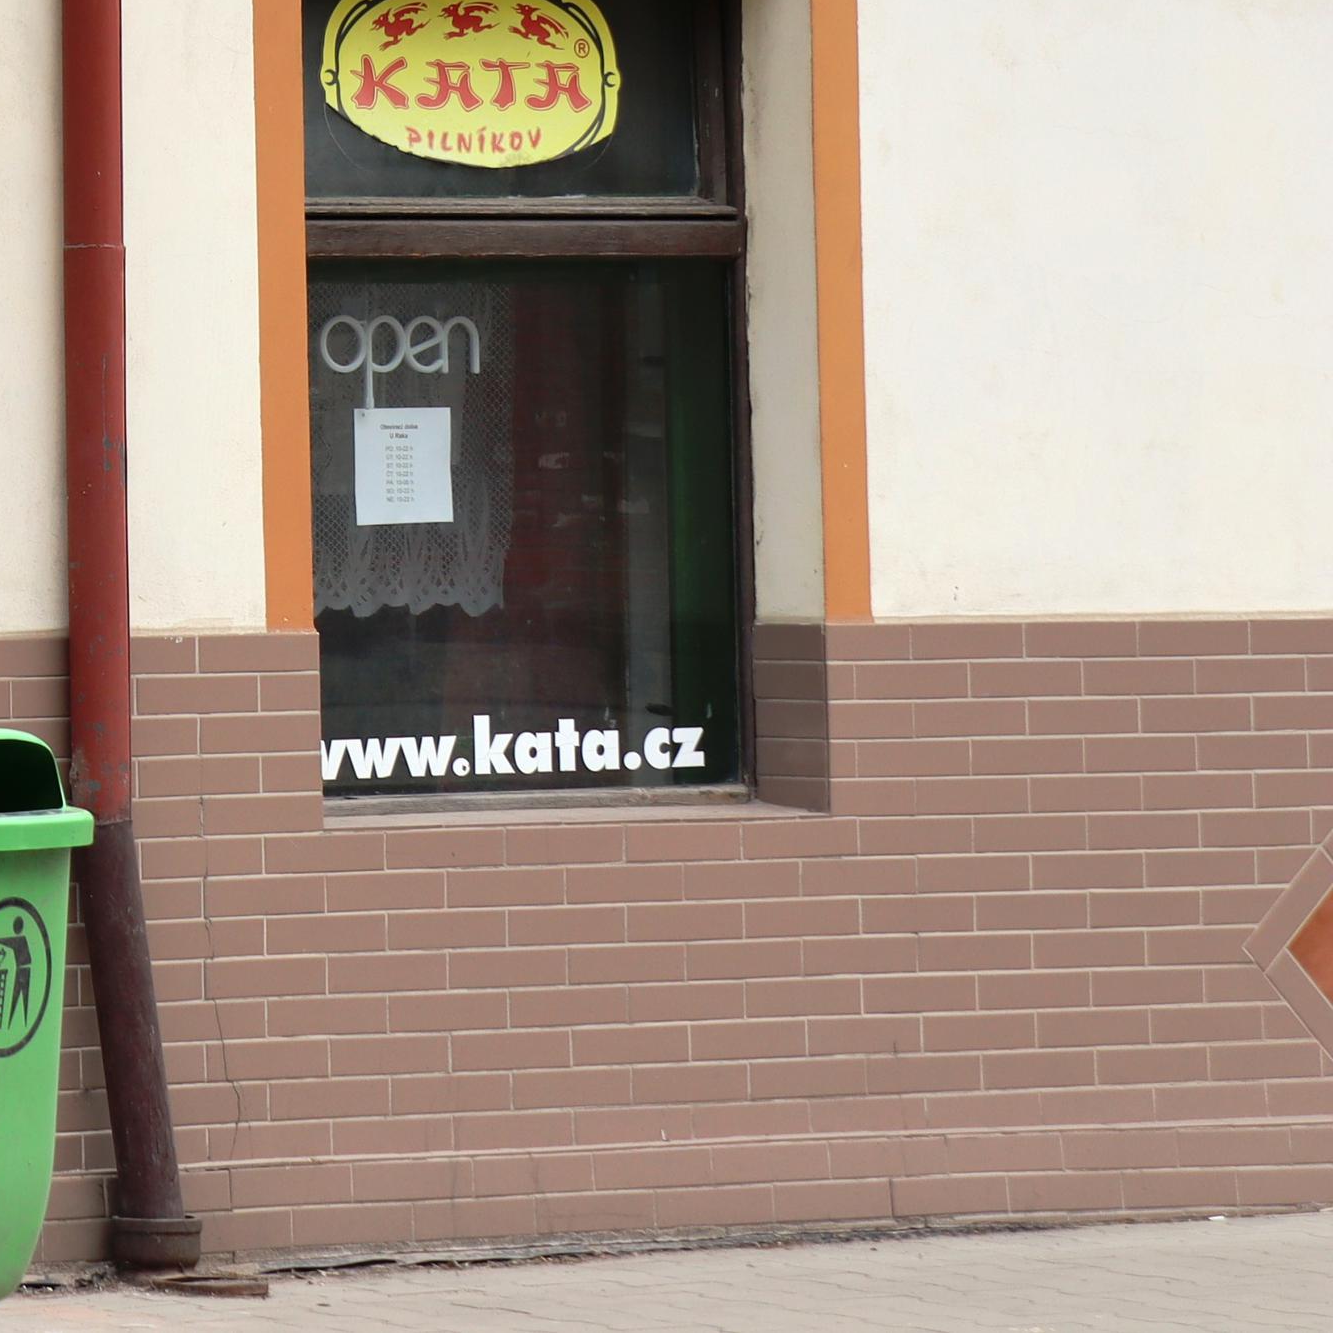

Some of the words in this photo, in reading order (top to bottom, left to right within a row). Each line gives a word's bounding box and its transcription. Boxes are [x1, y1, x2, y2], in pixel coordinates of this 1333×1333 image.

[350, 54, 592, 113] KATA
[405, 126, 541, 153] PILNÍKOV
[321, 315, 480, 409] open
[320, 714, 705, 780] www.kata.cz
